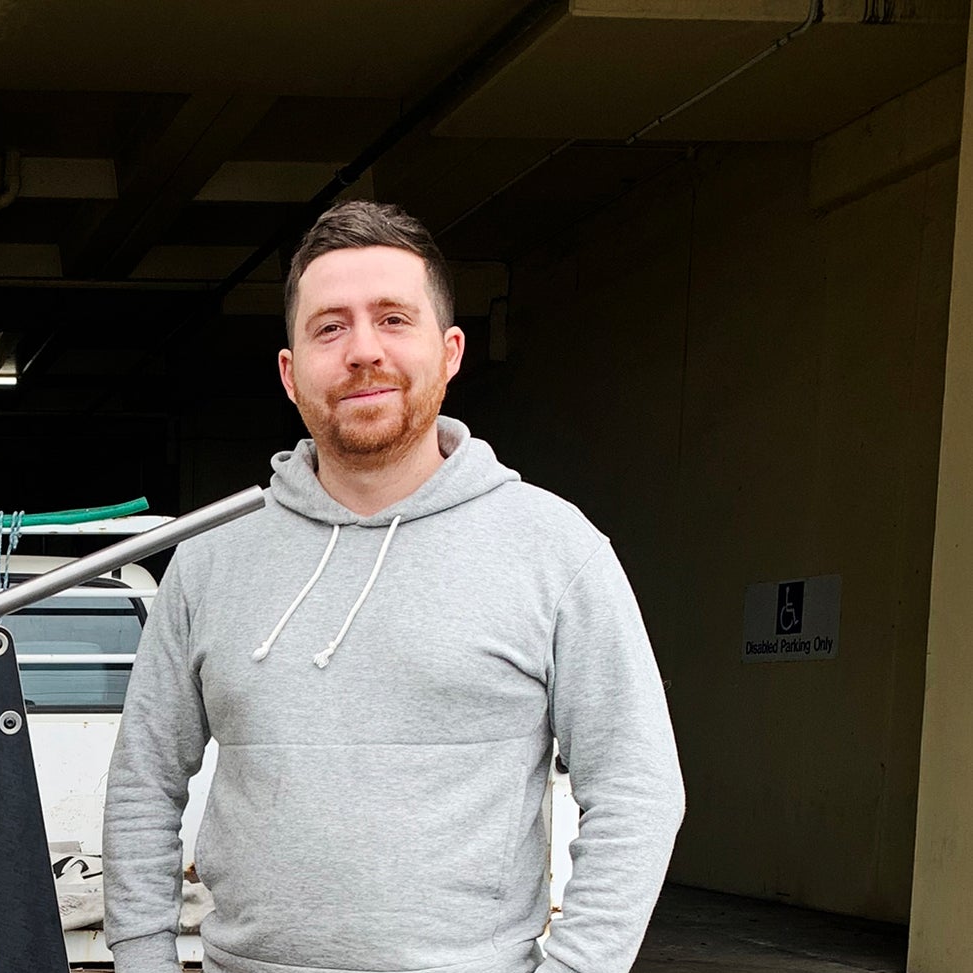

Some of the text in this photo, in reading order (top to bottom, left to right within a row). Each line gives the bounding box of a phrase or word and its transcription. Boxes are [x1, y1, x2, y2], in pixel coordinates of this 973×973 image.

[746, 636, 834, 655] Disabled Parking Only
